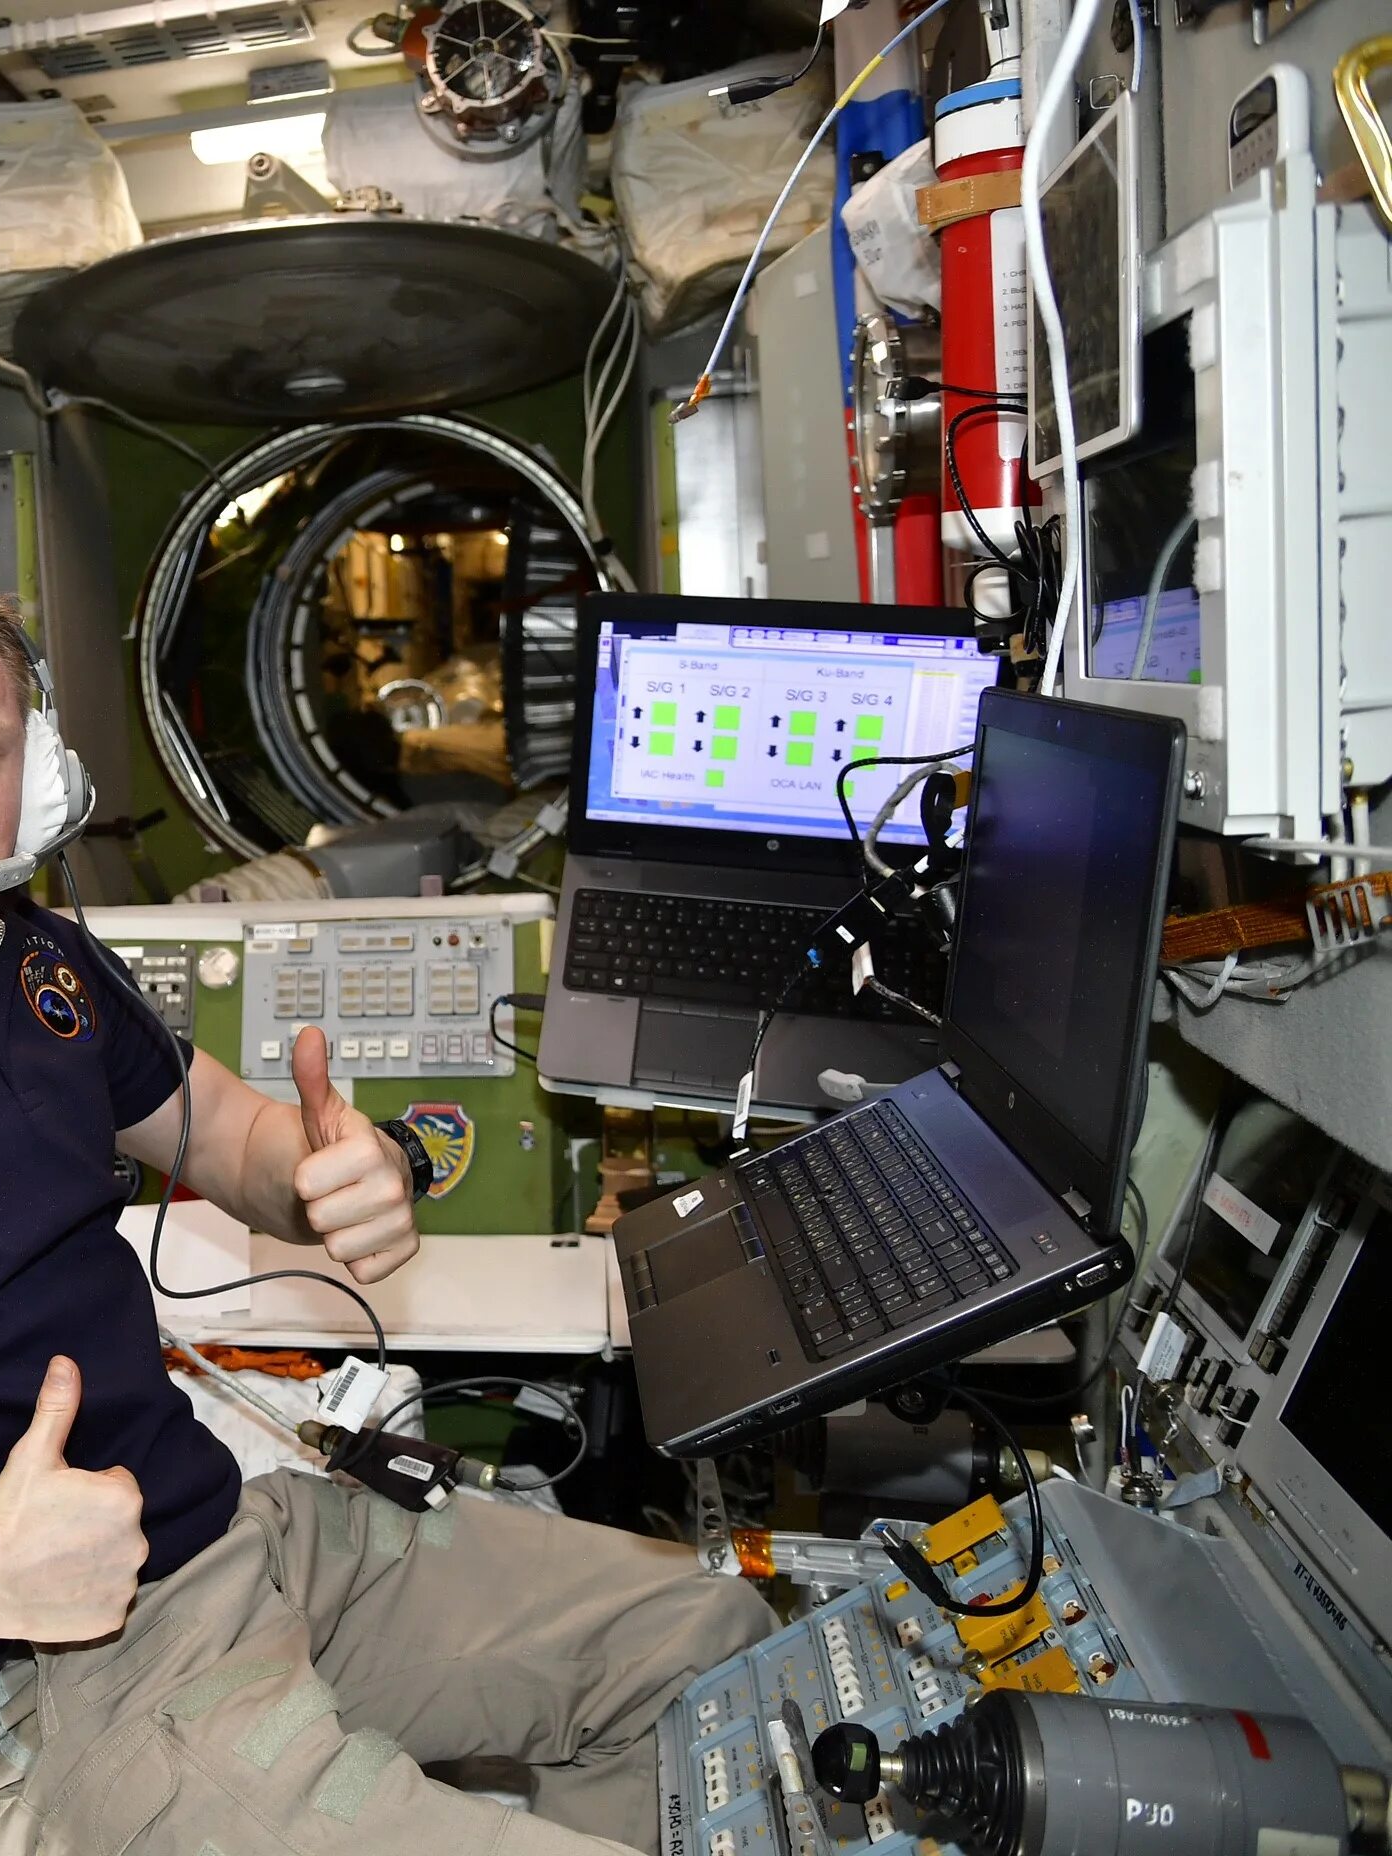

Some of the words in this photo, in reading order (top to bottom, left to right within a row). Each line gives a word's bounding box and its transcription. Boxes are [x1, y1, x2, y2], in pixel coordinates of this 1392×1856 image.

[646, 681, 673, 694] S/G
[679, 683, 686, 694] 1
[710, 684, 737, 697] S/G
[741, 686, 751, 698] 2
[786, 688, 813, 702] S/G
[818, 690, 827, 703] 3
[850, 692, 878, 705] S/G
[883, 694, 894, 706] 4
[797, 780, 822, 791] LAN
